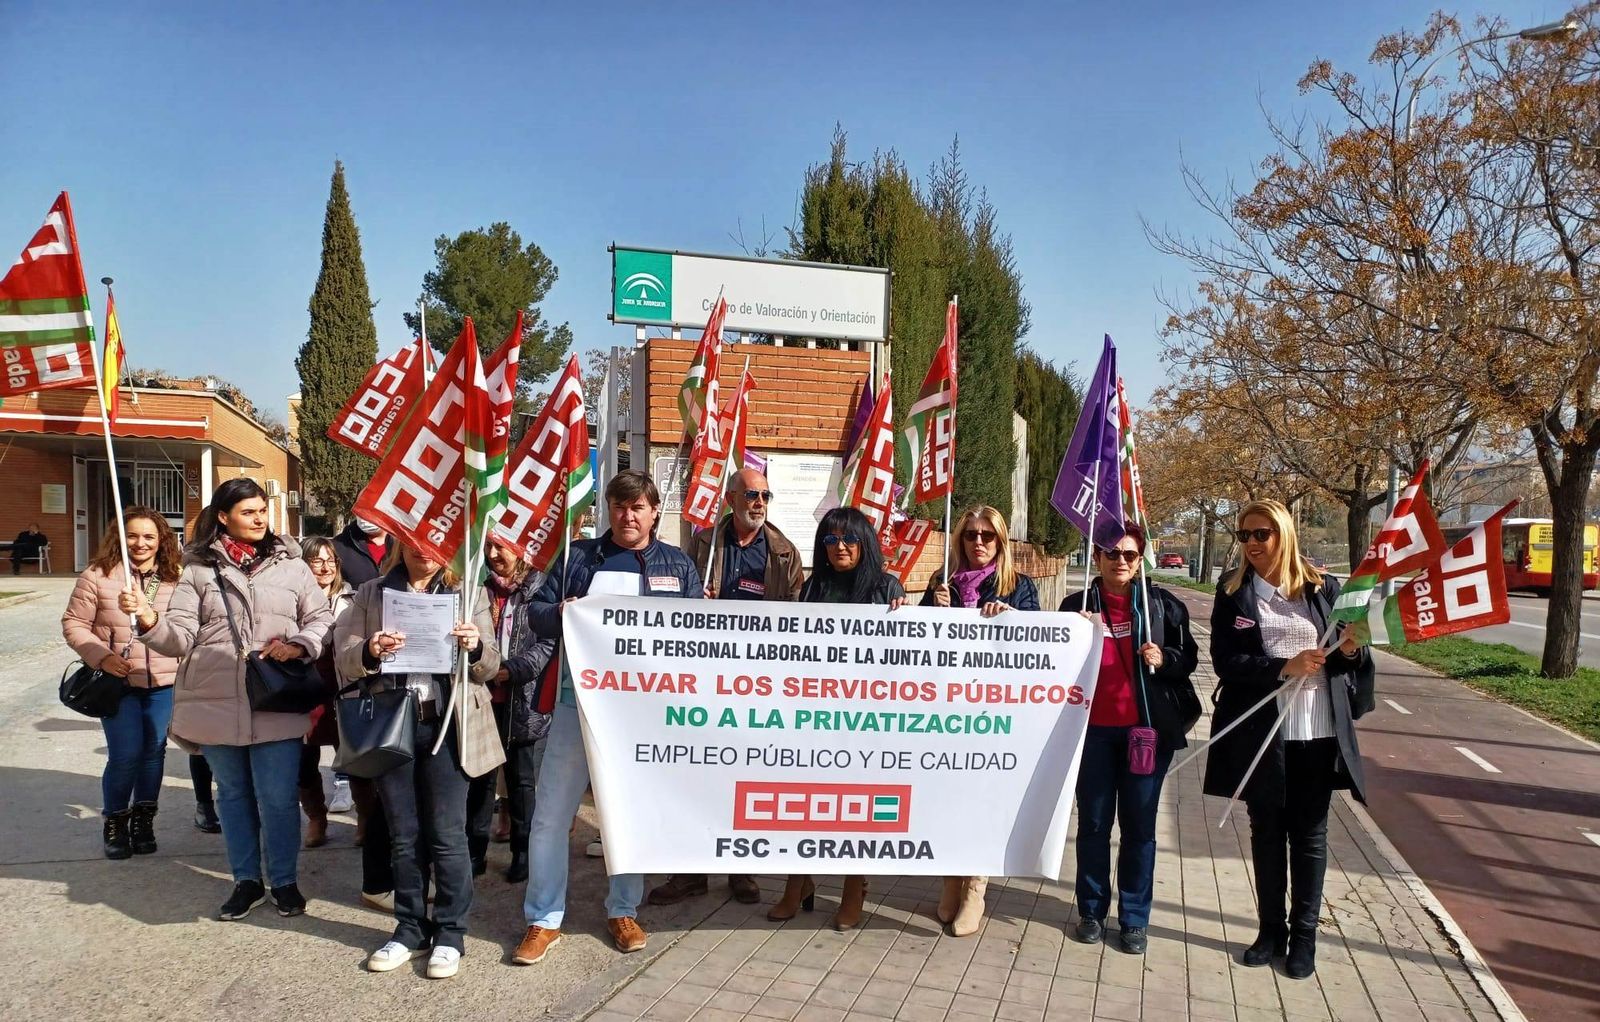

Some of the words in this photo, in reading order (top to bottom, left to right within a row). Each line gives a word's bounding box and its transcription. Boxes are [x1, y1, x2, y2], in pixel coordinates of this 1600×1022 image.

[702, 298, 736, 314] Cero
[740, 302, 752, 314] de
[756, 303, 807, 319] Valoración
[811, 310, 817, 322] y
[820, 308, 876, 325] Orientación
[603, 609, 637, 625] POR
[644, 611, 664, 627] LA
[671, 612, 771, 631] COBERTURA
[778, 617, 799, 632] DE
[805, 618, 834, 634] LAS
[841, 619, 926, 637] VACANTES
[933, 623, 942, 638] Y
[948, 623, 1070, 642] SUSTITUCIONES
[615, 639, 646, 655] DEL
[653, 640, 740, 658] PERSONAL
[747, 644, 821, 661] LABORAL
[827, 647, 847, 663] DE
[855, 648, 874, 664] LA
[880, 649, 931, 666] JUNTA
[938, 651, 957, 666] DE
[962, 652, 1056, 669] ANDALUCIA.
[581, 670, 697, 693] SALVAR
[717, 676, 772, 695] LOS
[783, 678, 936, 701] SERVICIOS
[947, 679, 1090, 708] PÚBLICOS,
[666, 707, 708, 727] NO
[718, 708, 738, 727] A
[748, 709, 784, 728] LA
[795, 710, 1012, 734] PRIVATIZACIÓN
[635, 744, 738, 765] EMPLEO
[747, 744, 851, 769] PÚBLICO
[860, 751, 873, 769] Y
[882, 752, 911, 770] DE
[920, 753, 1017, 770] CALIDAD
[745, 792, 868, 821] CCOO
[716, 838, 769, 857] FSC
[798, 839, 934, 859] GRANADA
